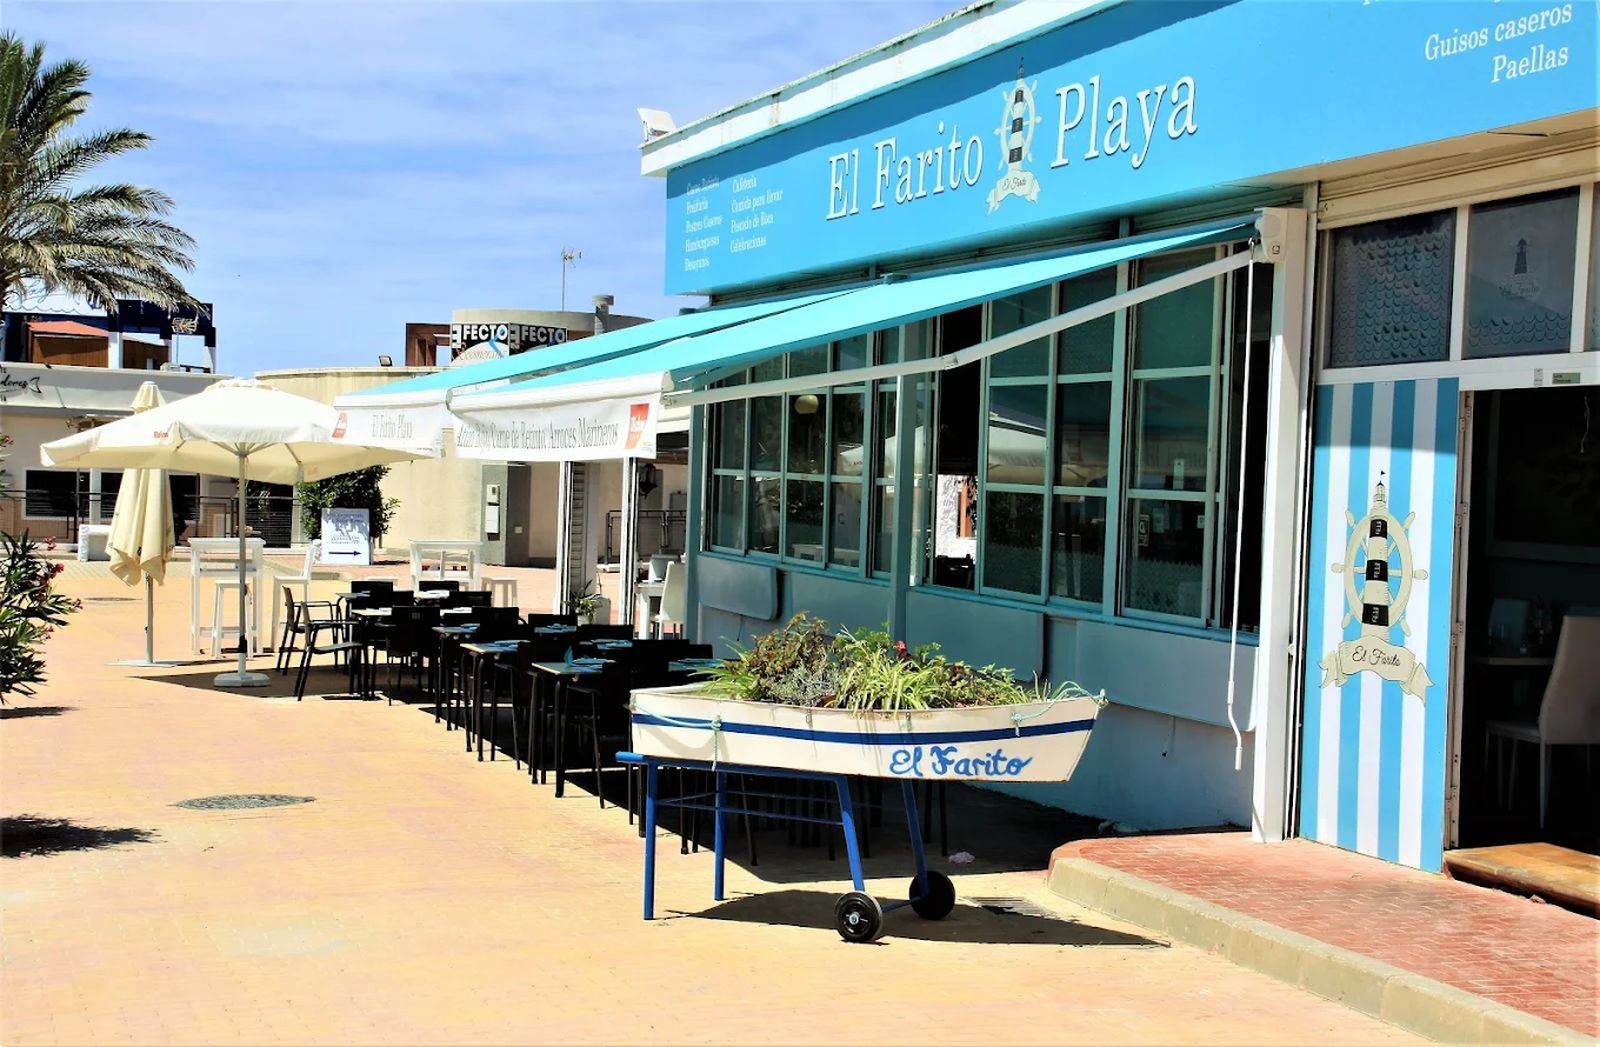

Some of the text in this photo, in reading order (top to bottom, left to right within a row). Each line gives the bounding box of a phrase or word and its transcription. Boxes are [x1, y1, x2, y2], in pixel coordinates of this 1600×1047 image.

[1425, 3, 1573, 61] Guisos caseros
[1490, 44, 1569, 84] Paellas
[826, 73, 1199, 221] El Farito Playa
[547, 418, 577, 449] Arroces
[577, 416, 619, 448] Marineros
[1352, 644, 1401, 668] El Farito
[889, 745, 1033, 778] El Farito
